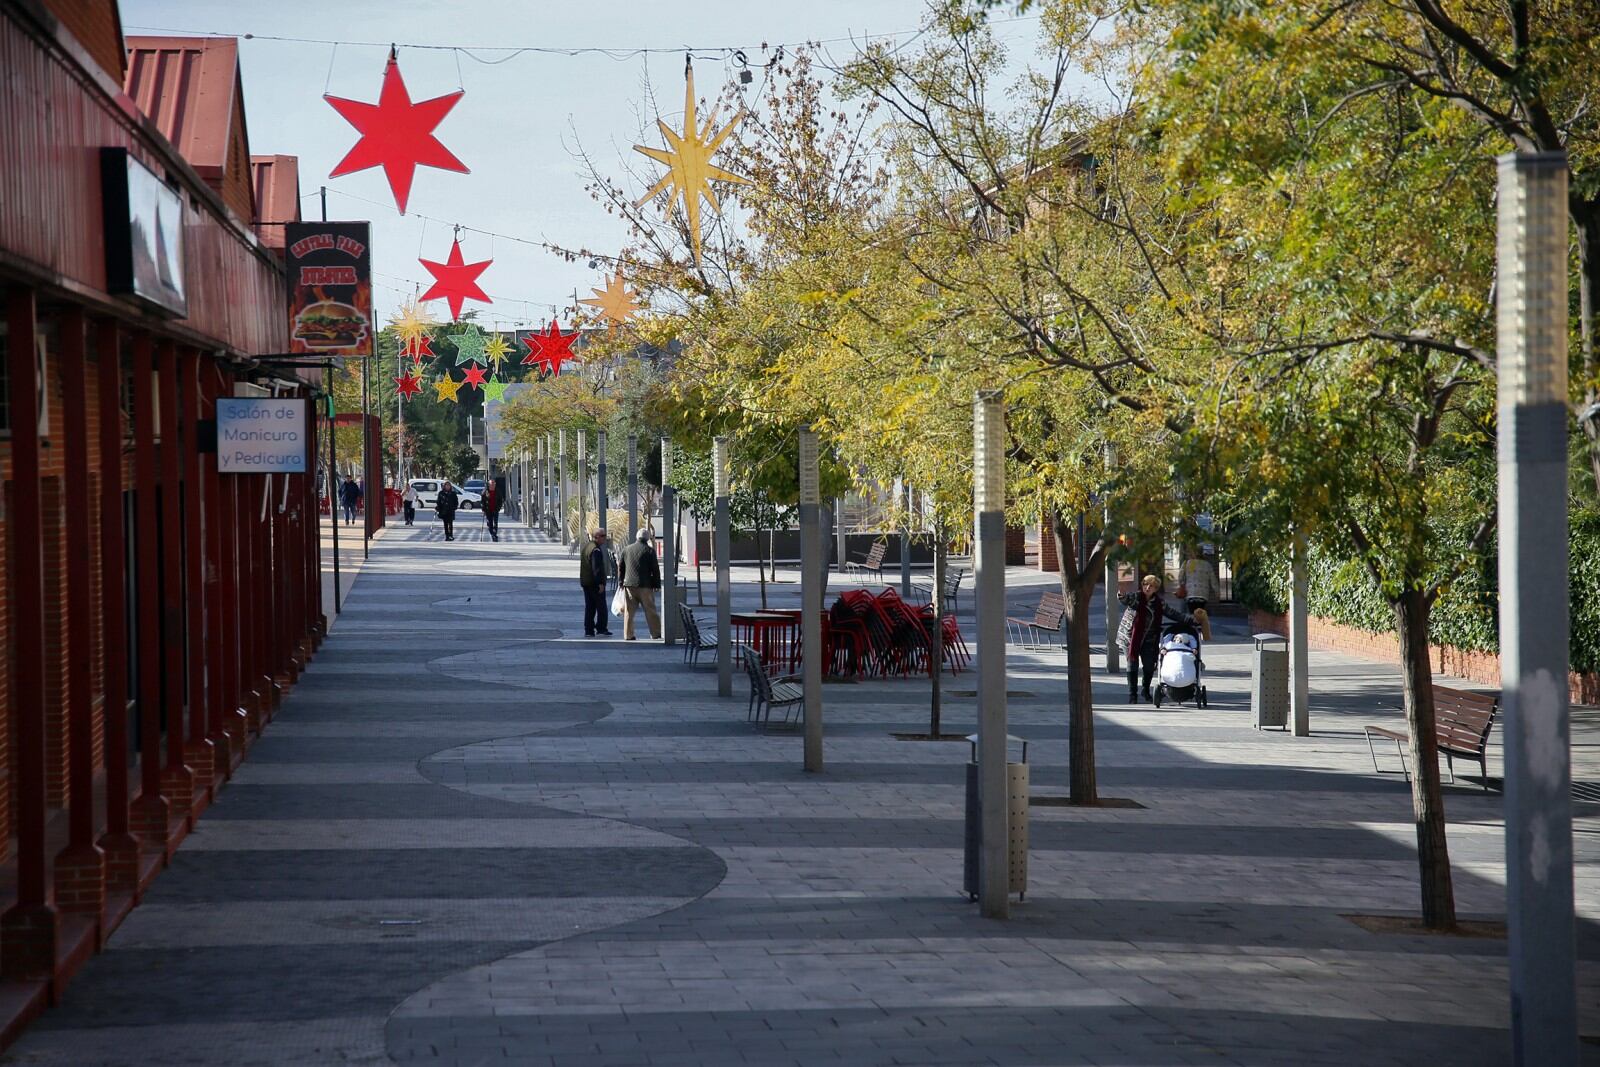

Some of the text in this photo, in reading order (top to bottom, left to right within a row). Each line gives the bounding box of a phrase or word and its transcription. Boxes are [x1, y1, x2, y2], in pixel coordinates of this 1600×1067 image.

[290, 233, 365, 259] CENTRAL PARK
[227, 405, 295, 419] Salón de
[224, 428, 298, 441] Manicura
[222, 451, 301, 467] y Pedicura
